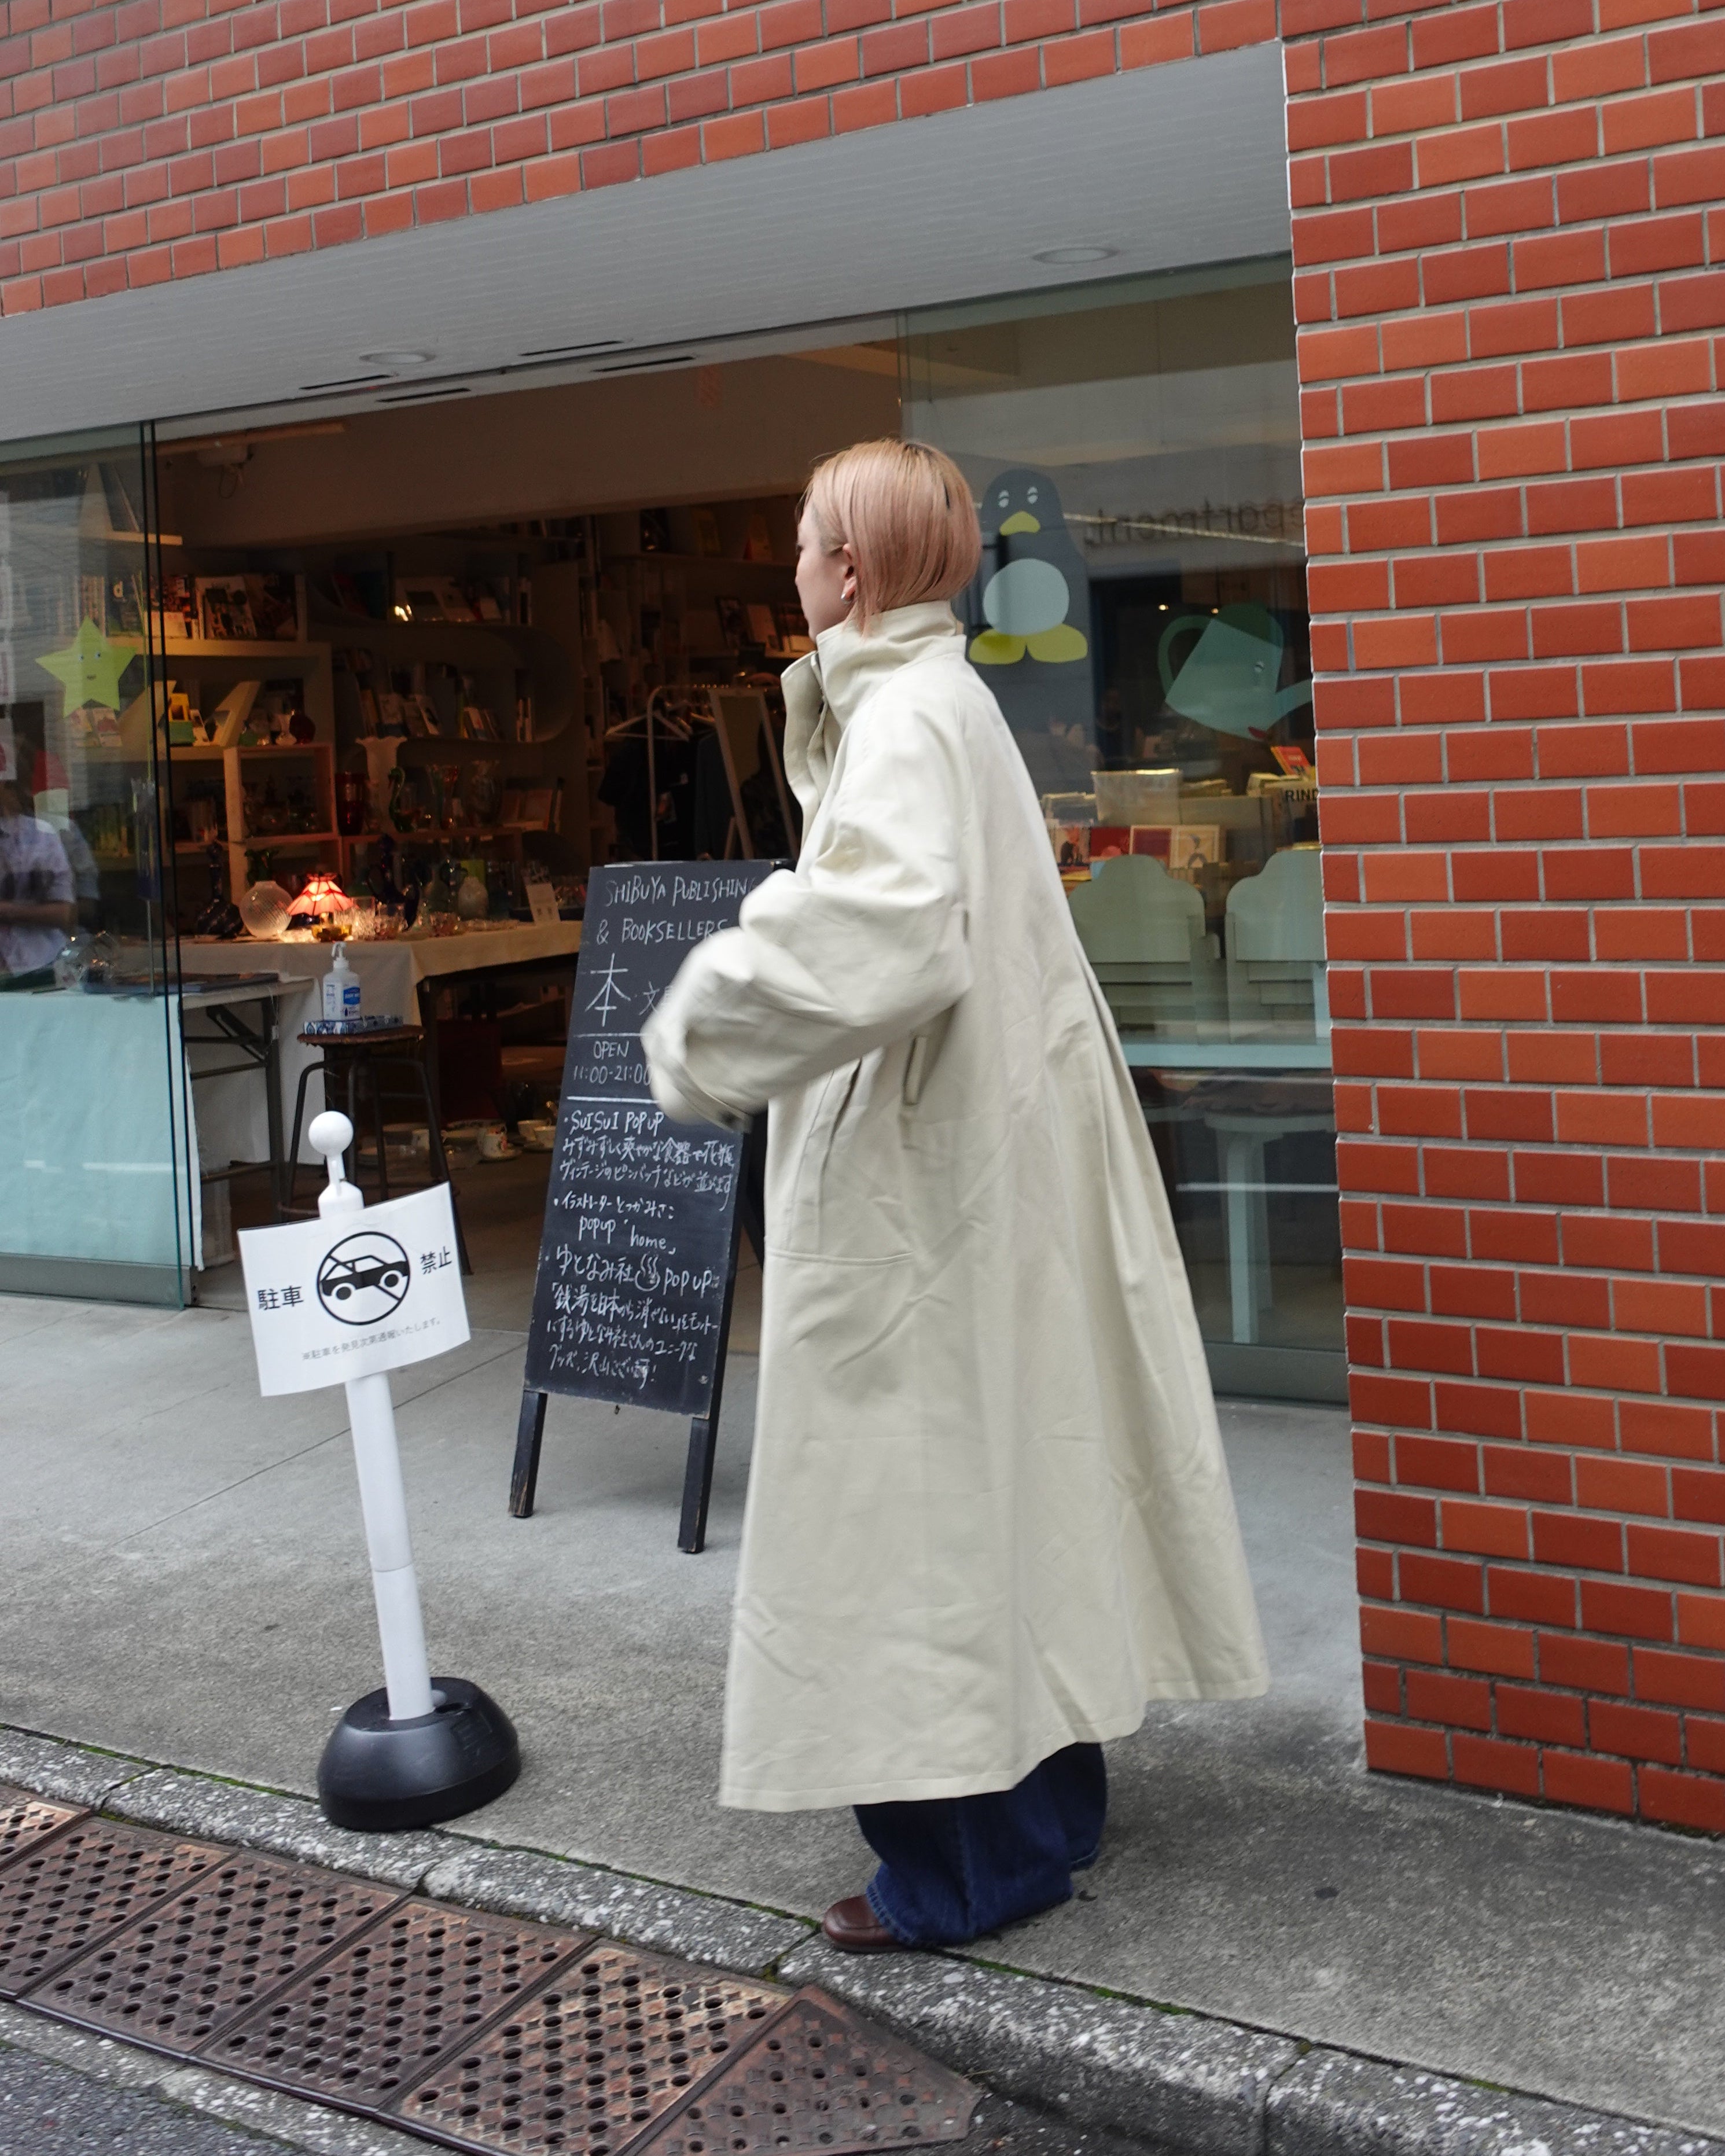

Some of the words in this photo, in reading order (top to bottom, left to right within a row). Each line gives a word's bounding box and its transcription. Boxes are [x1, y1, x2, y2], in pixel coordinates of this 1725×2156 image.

[605, 875, 666, 907] SHIBUYA
[672, 876, 755, 906] PUBLISHIN
[596, 919, 609, 945] &
[593, 1040, 630, 1059] OPEN
[573, 1063, 652, 1086] 11:00-21:00
[257, 1285, 304, 1311] 駐車
[420, 1246, 453, 1275] 禁止
